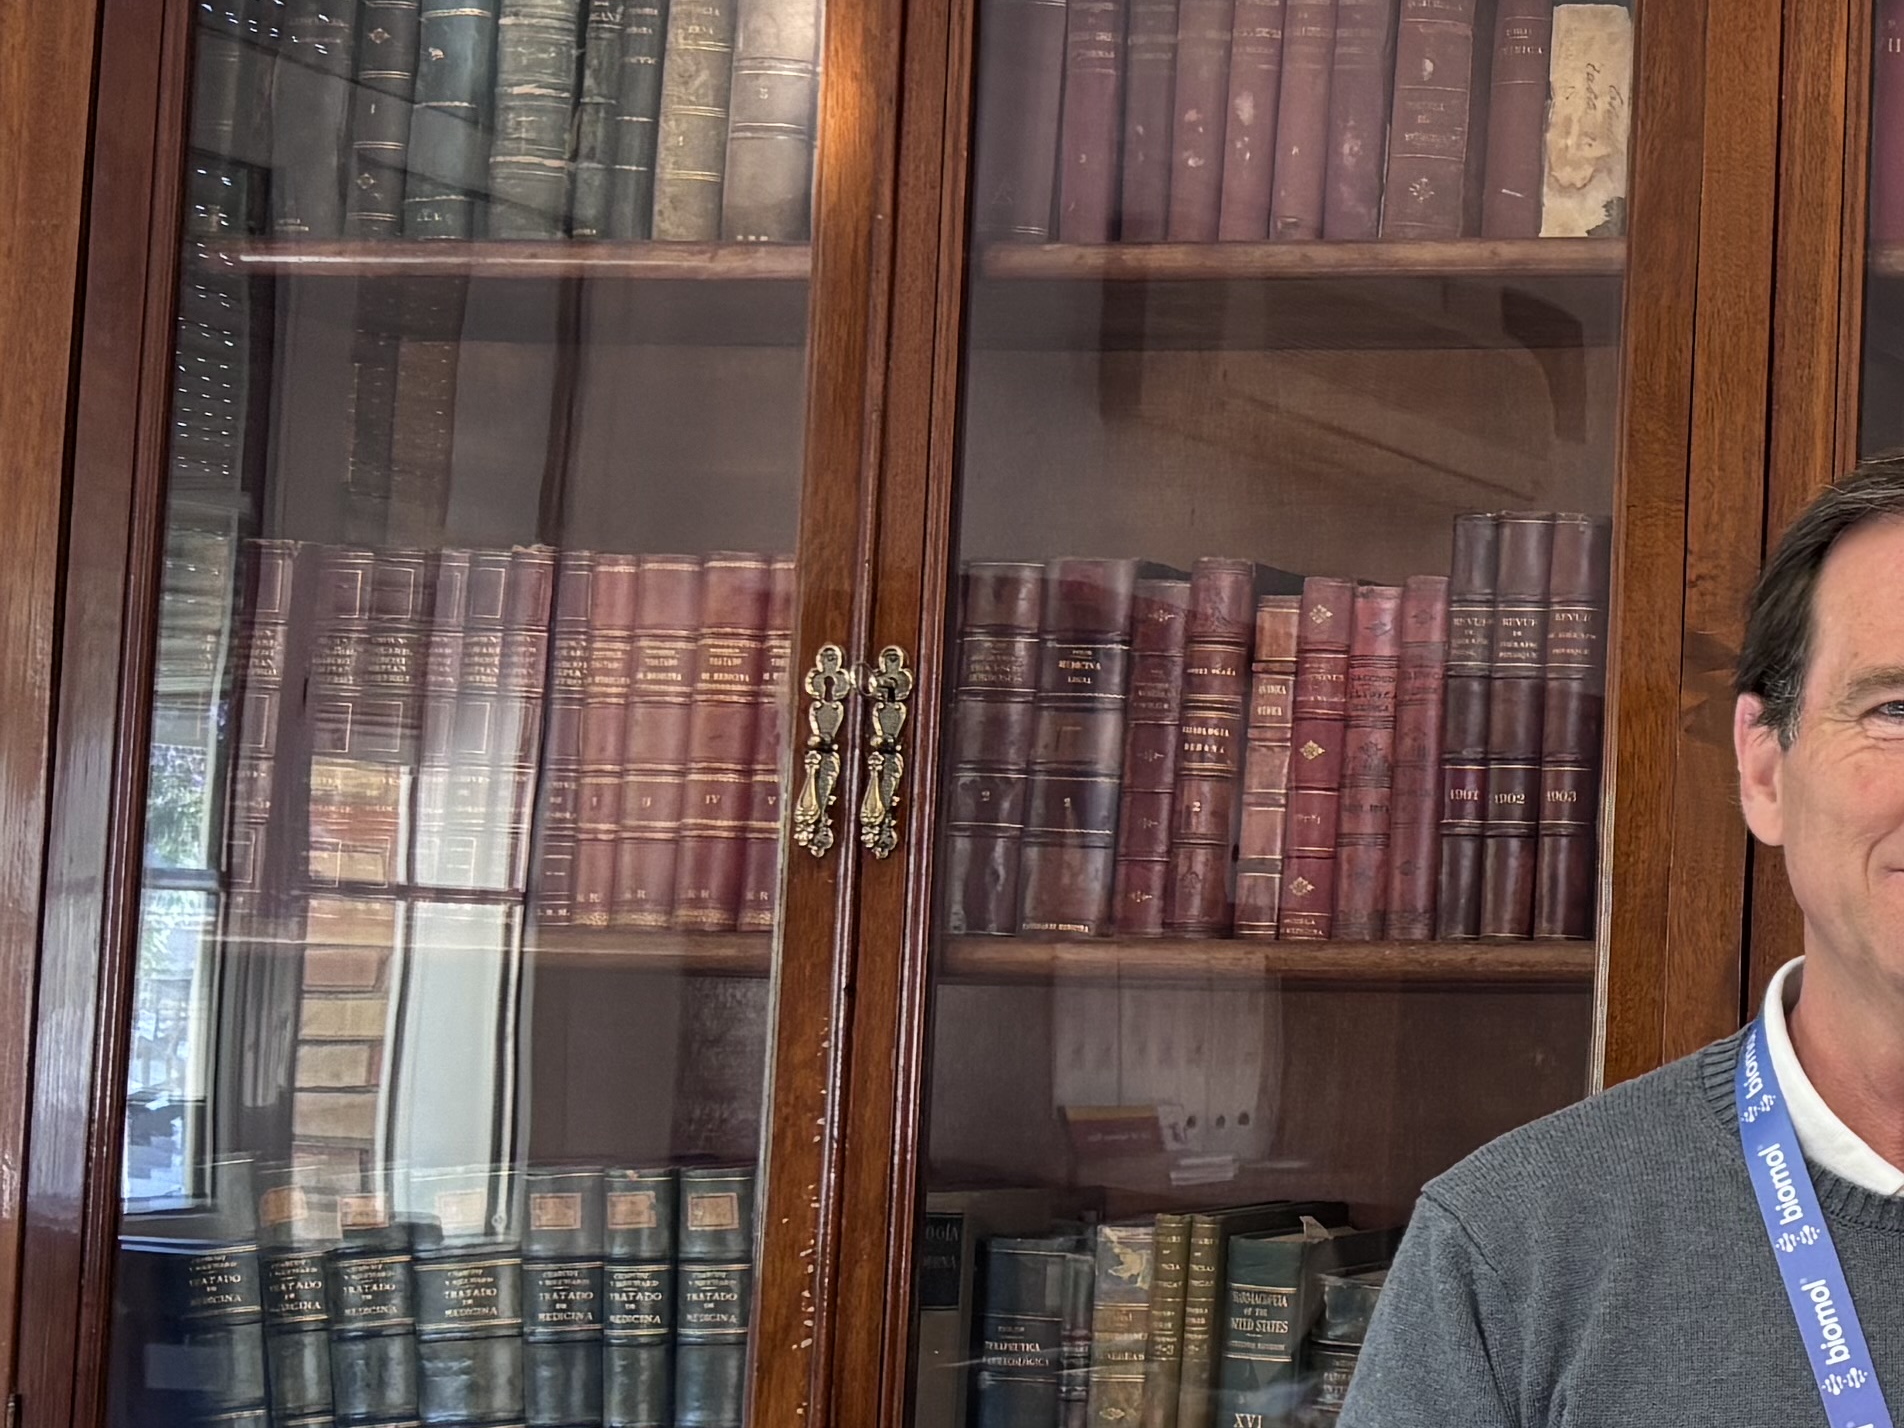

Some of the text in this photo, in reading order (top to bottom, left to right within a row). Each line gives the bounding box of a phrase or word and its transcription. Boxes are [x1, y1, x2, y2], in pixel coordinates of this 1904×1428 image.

[1757, 1145, 1804, 1226] biomol
[539, 1291, 594, 1301] TRATADO
[610, 1292, 662, 1302] TRATADO
[687, 1292, 738, 1301] TRATADO
[1801, 1280, 1851, 1365] biomol
